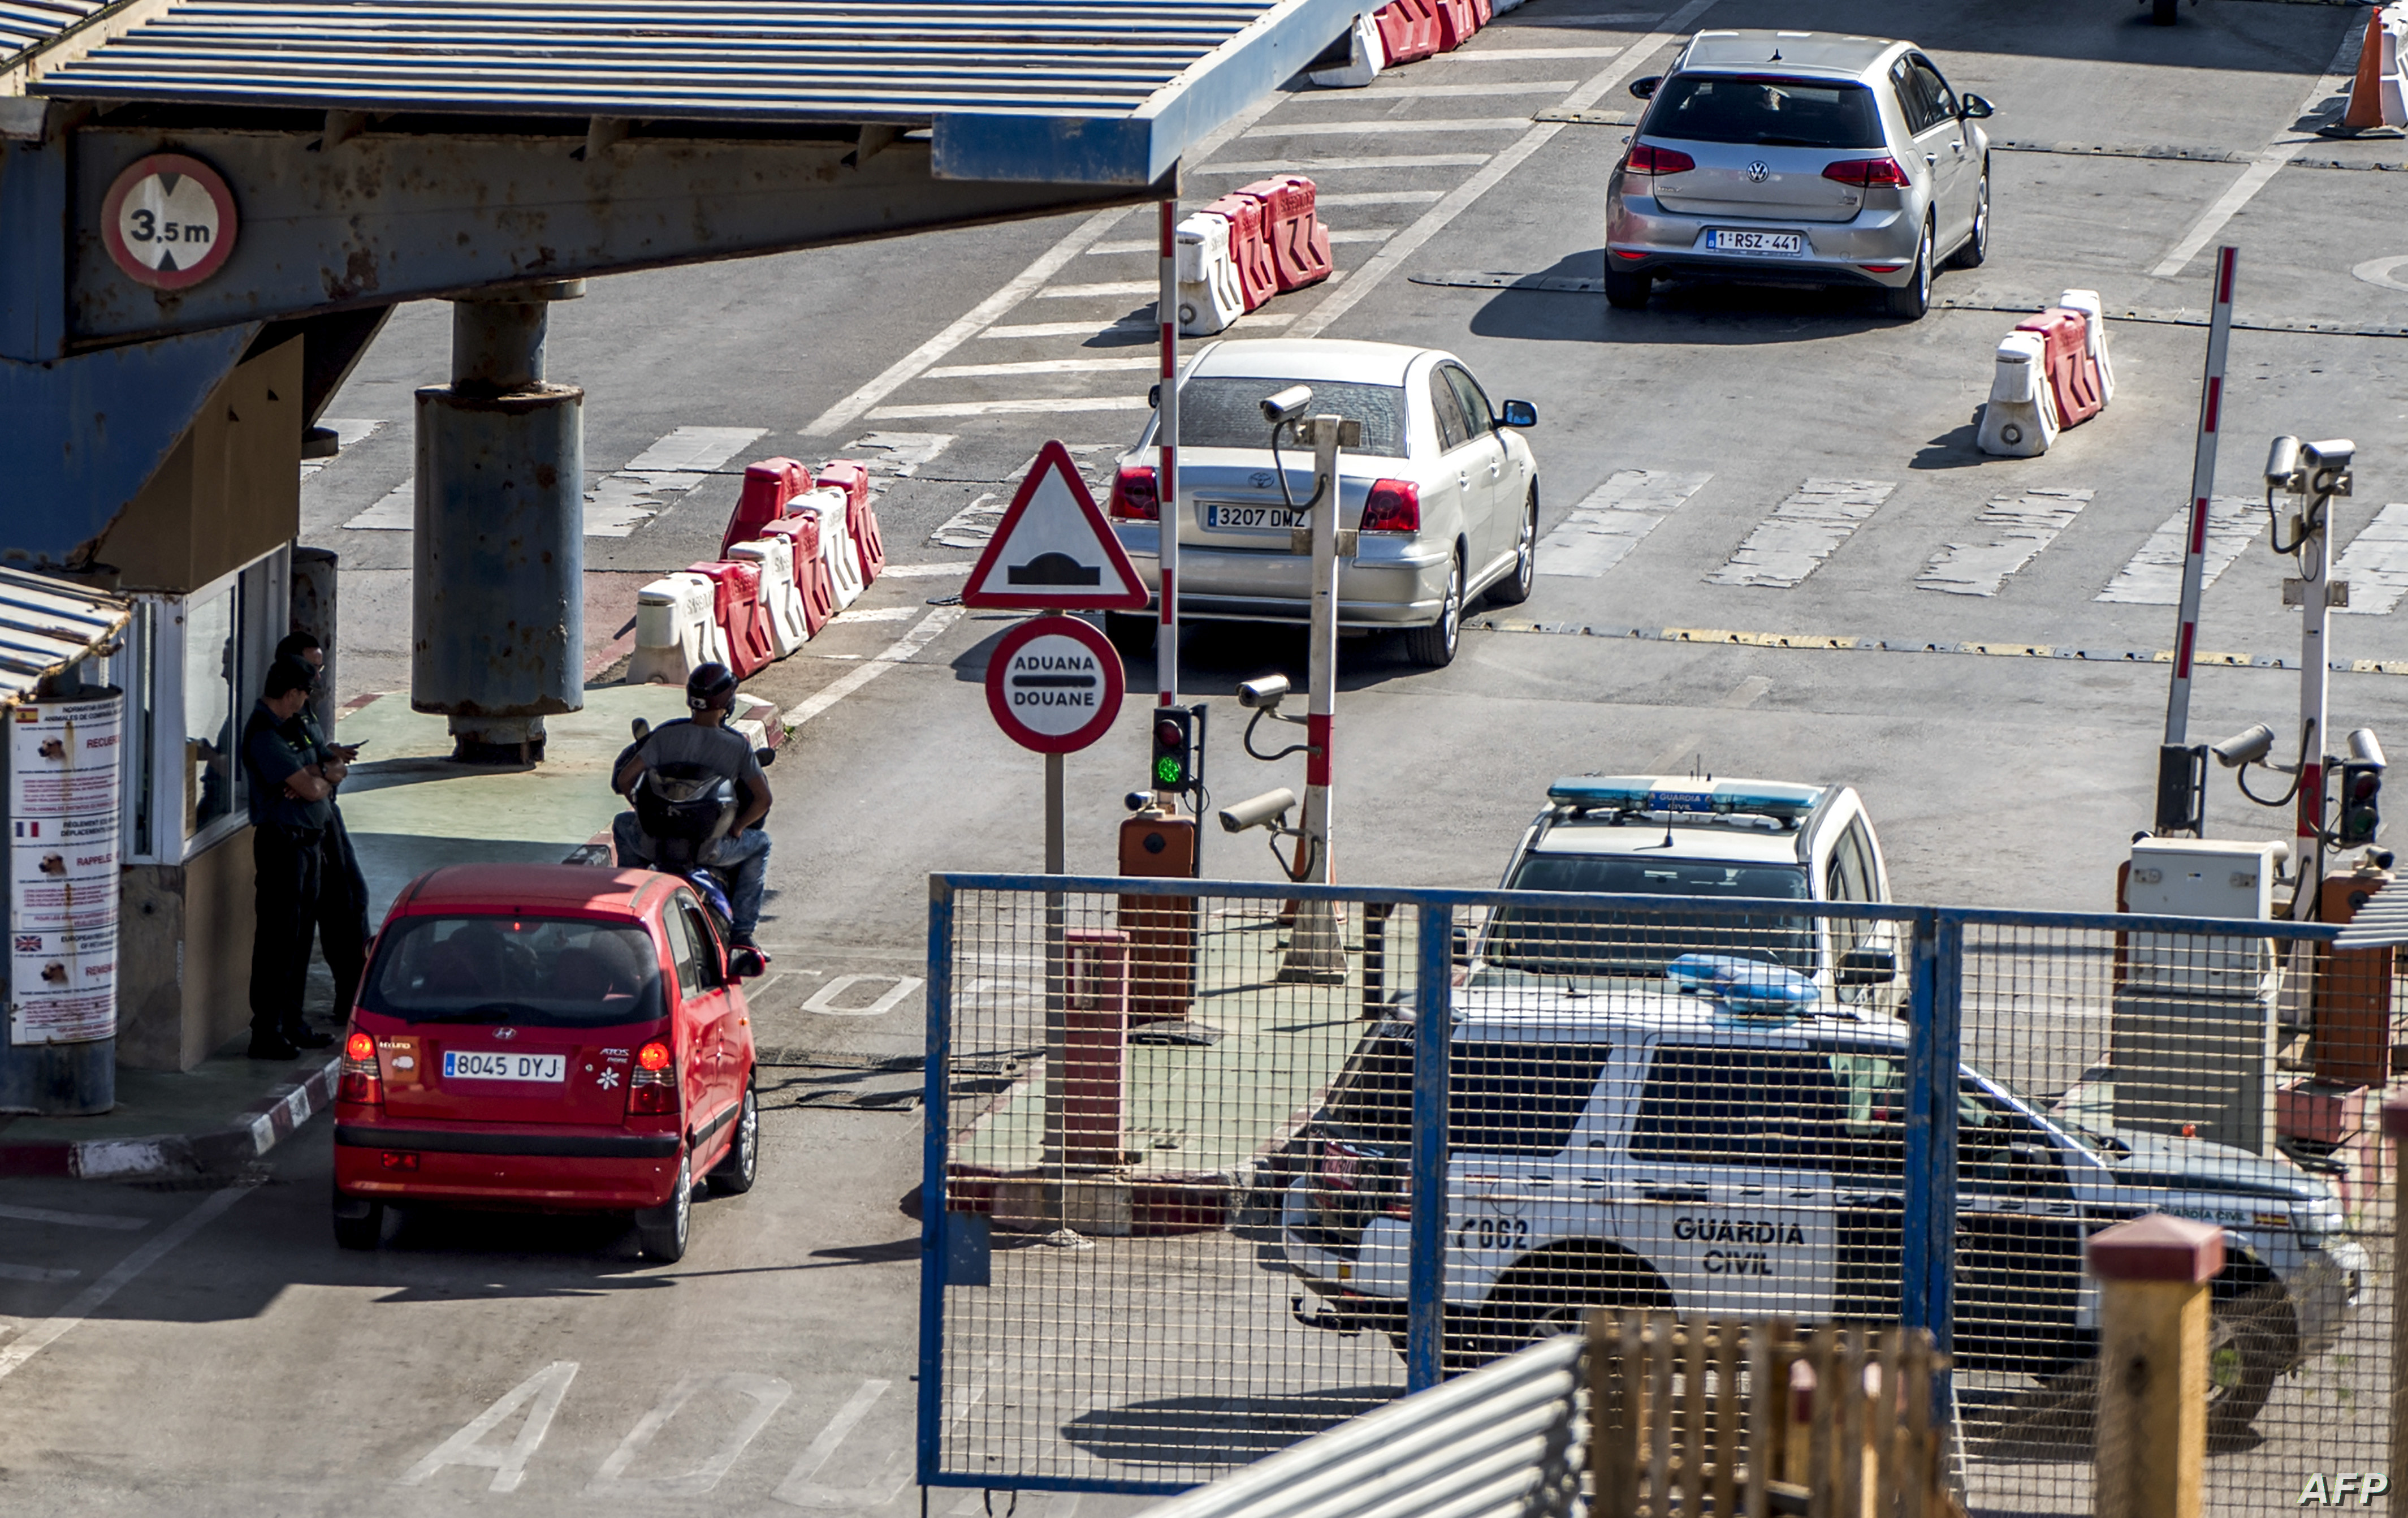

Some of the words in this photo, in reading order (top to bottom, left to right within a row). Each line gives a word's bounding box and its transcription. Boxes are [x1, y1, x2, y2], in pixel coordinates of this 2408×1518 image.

[1220, 508, 1265, 525] 3207
[1270, 510, 1305, 527] DMZ
[1014, 657, 1094, 670] ADUANA
[1014, 692, 1094, 706] DOUANE
[1659, 793, 1701, 802] GUARDIA
[457, 1055, 507, 1075] 8045
[518, 1058, 557, 1077] DYJ
[1674, 1217, 1804, 1245] GUARDIA
[1703, 1249, 1773, 1275] CIVIL
